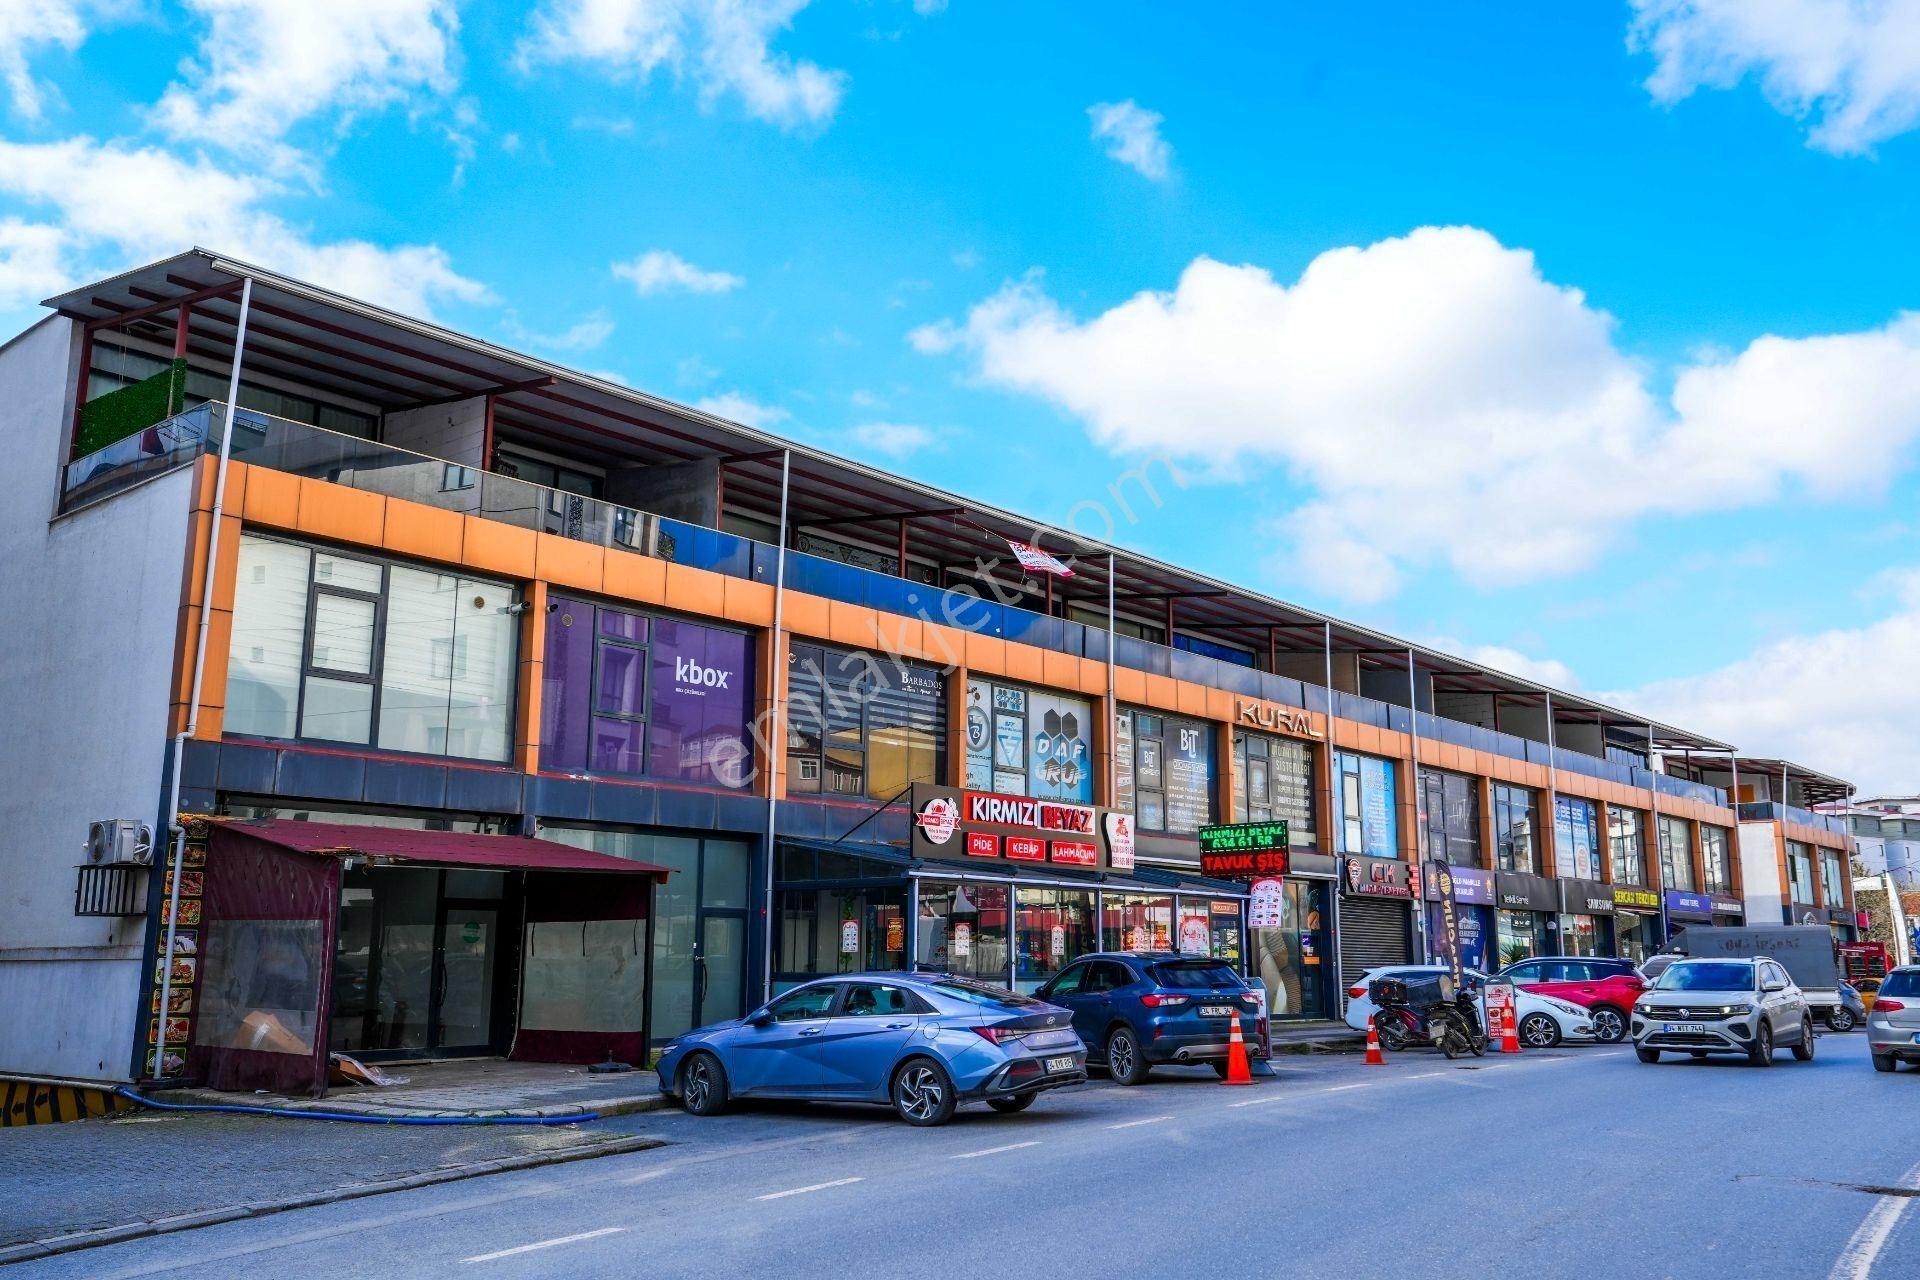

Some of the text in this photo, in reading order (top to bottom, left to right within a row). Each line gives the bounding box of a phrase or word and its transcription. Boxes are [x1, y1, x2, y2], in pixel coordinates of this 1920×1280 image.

[676, 656, 728, 689] kbox
[901, 671, 943, 690] BARBADOS
[1237, 700, 1324, 737] KURAL
[1037, 738, 1085, 759] DAF
[972, 796, 1093, 832] KIRMIZI BEYAZ
[973, 837, 993, 851] PİDE
[1012, 841, 1039, 855] KEBAP
[1213, 837, 1236, 849] 634
[1238, 836, 1253, 848] 61
[1054, 846, 1095, 860] LAHMACUN
[1203, 850, 1284, 871] TAVUK ŞİŞ
[1587, 898, 1614, 911] SAMSUNG
